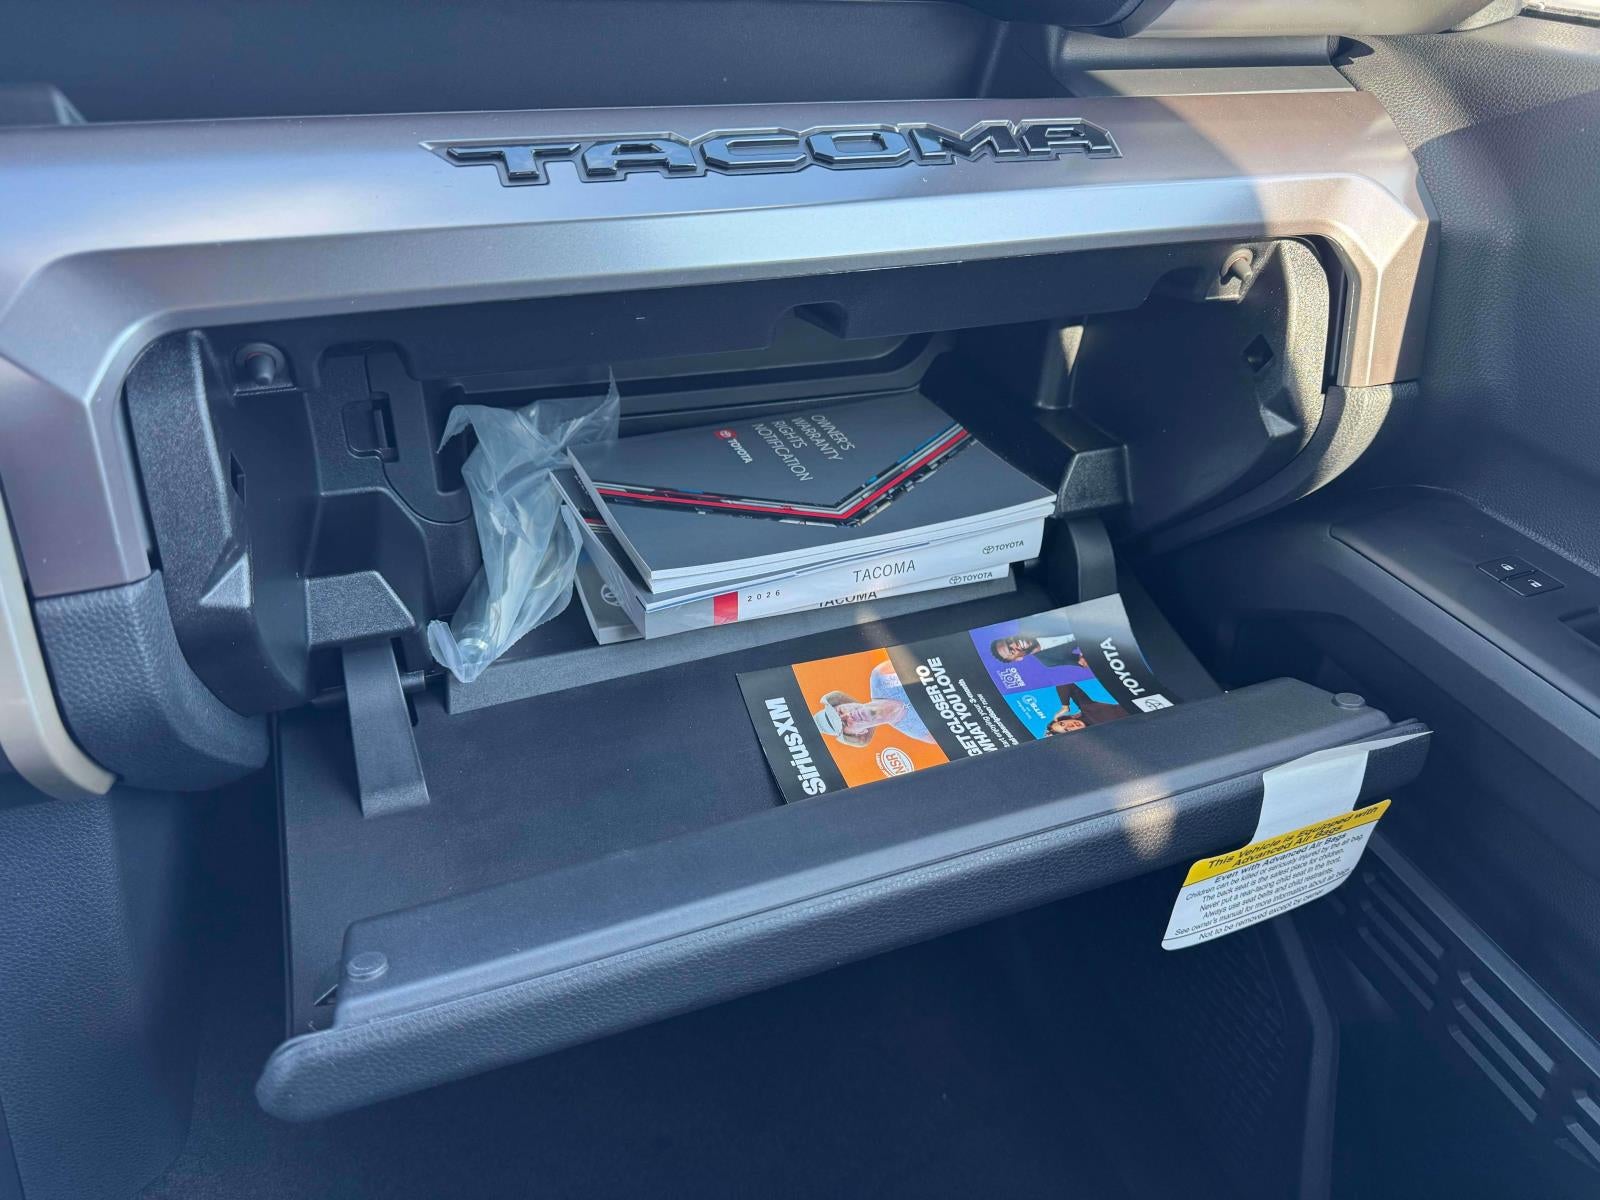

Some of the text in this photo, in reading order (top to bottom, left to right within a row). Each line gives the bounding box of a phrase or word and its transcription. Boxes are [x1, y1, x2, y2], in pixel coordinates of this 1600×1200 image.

[444, 121, 1114, 182] TACOMA
[727, 438, 754, 465] TOYOTA
[752, 423, 814, 481] NOTIFICATION
[772, 420, 808, 450] RIGHTS
[791, 416, 844, 461] WARRANTY
[811, 414, 856, 451] OWNER'S
[994, 540, 1024, 551] TOYOTA
[853, 560, 916, 583] TACOMA
[962, 572, 993, 582] TOYOTA
[747, 589, 780, 602] 2026
[1100, 637, 1145, 696] TOYOTA
[915, 665, 983, 757] GET CLOSER TO
[927, 656, 998, 753] WHAT YOU LOVE
[958, 678, 977, 704] 3-month
[973, 701, 987, 717] your
[1029, 703, 1047, 719] HITS
[765, 697, 827, 795] SiriusXM
[982, 714, 1003, 741] enjoying
[1208, 806, 1379, 869] This Vehicle is Equipped with
[1214, 833, 1347, 884] Even with Advanced Air Bags
[1232, 825, 1344, 868] Advanced Air Bags
[1185, 886, 1216, 901] Children
[1216, 881, 1229, 890] can
[1241, 871, 1258, 881] killed
[1267, 857, 1296, 873] seriously
[1298, 849, 1321, 861] injured
[1200, 900, 1221, 912] Never
[1221, 896, 1233, 906] put
[1239, 881, 1275, 898] rear-facing
[1275, 875, 1292, 886] child
[1292, 869, 1307, 879] seat
[1202, 893, 1216, 903] The
[1217, 887, 1233, 898] back
[1235, 881, 1250, 892] seat
[1257, 875, 1269, 884] the
[1269, 869, 1289, 880] safest
[1289, 861, 1308, 873] place
[1174, 926, 1190, 936] See
[1191, 917, 1218, 932] owner's
[1219, 907, 1245, 921] manual
[1254, 898, 1272, 909] more
[1273, 885, 1308, 901] information
[1308, 876, 1327, 888] about
[1202, 906, 1227, 920] Always
[1228, 901, 1241, 910] use
[1242, 895, 1257, 905] seat
[1257, 889, 1273, 900] belts
[1274, 884, 1288, 894] and
[1288, 876, 1304, 888] child
[1198, 930, 1213, 941] Not
[1235, 910, 1267, 927] removed
[1268, 900, 1292, 915] except
